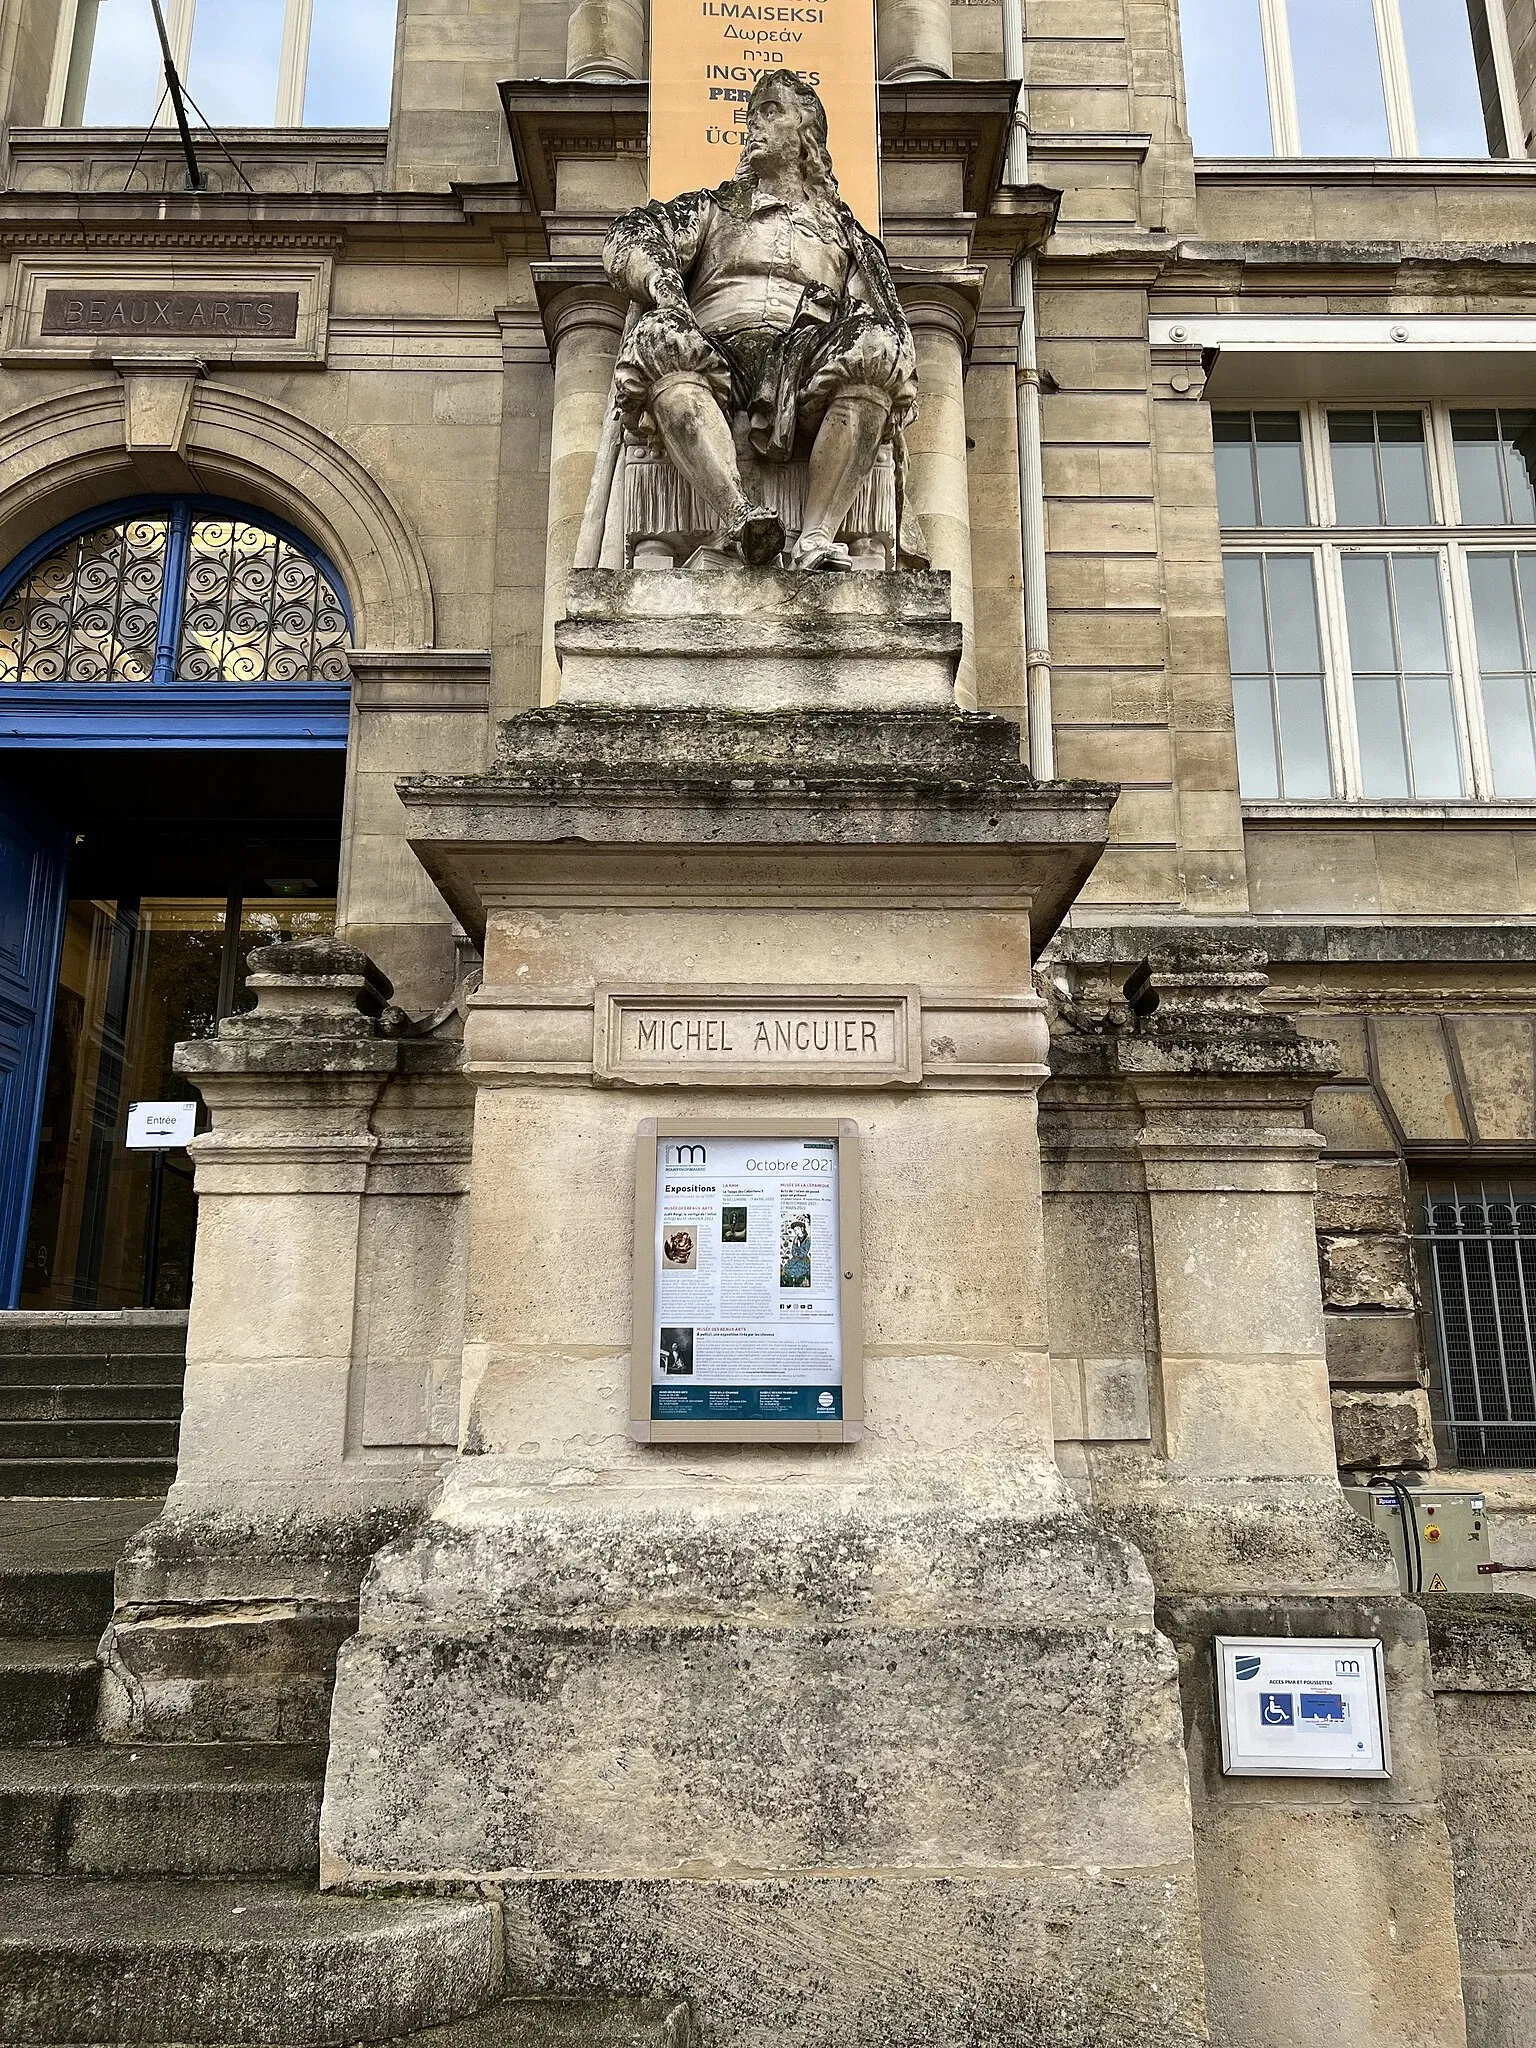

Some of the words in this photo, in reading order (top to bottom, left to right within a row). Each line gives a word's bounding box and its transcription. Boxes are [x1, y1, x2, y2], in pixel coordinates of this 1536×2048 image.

[703, 2, 823, 23] ILMAISEKSI
[723, 24, 803, 44] Δωρεάν
[66, 300, 274, 327] BEAUX-ARTS
[636, 1020, 733, 1051] MICHEL
[753, 1020, 878, 1051] ANGUIER
[146, 1116, 177, 1124] Entrée
[746, 1158, 799, 1171] Octobre
[802, 1158, 833, 1172] 2021
[665, 1184, 716, 1194] Expositions
